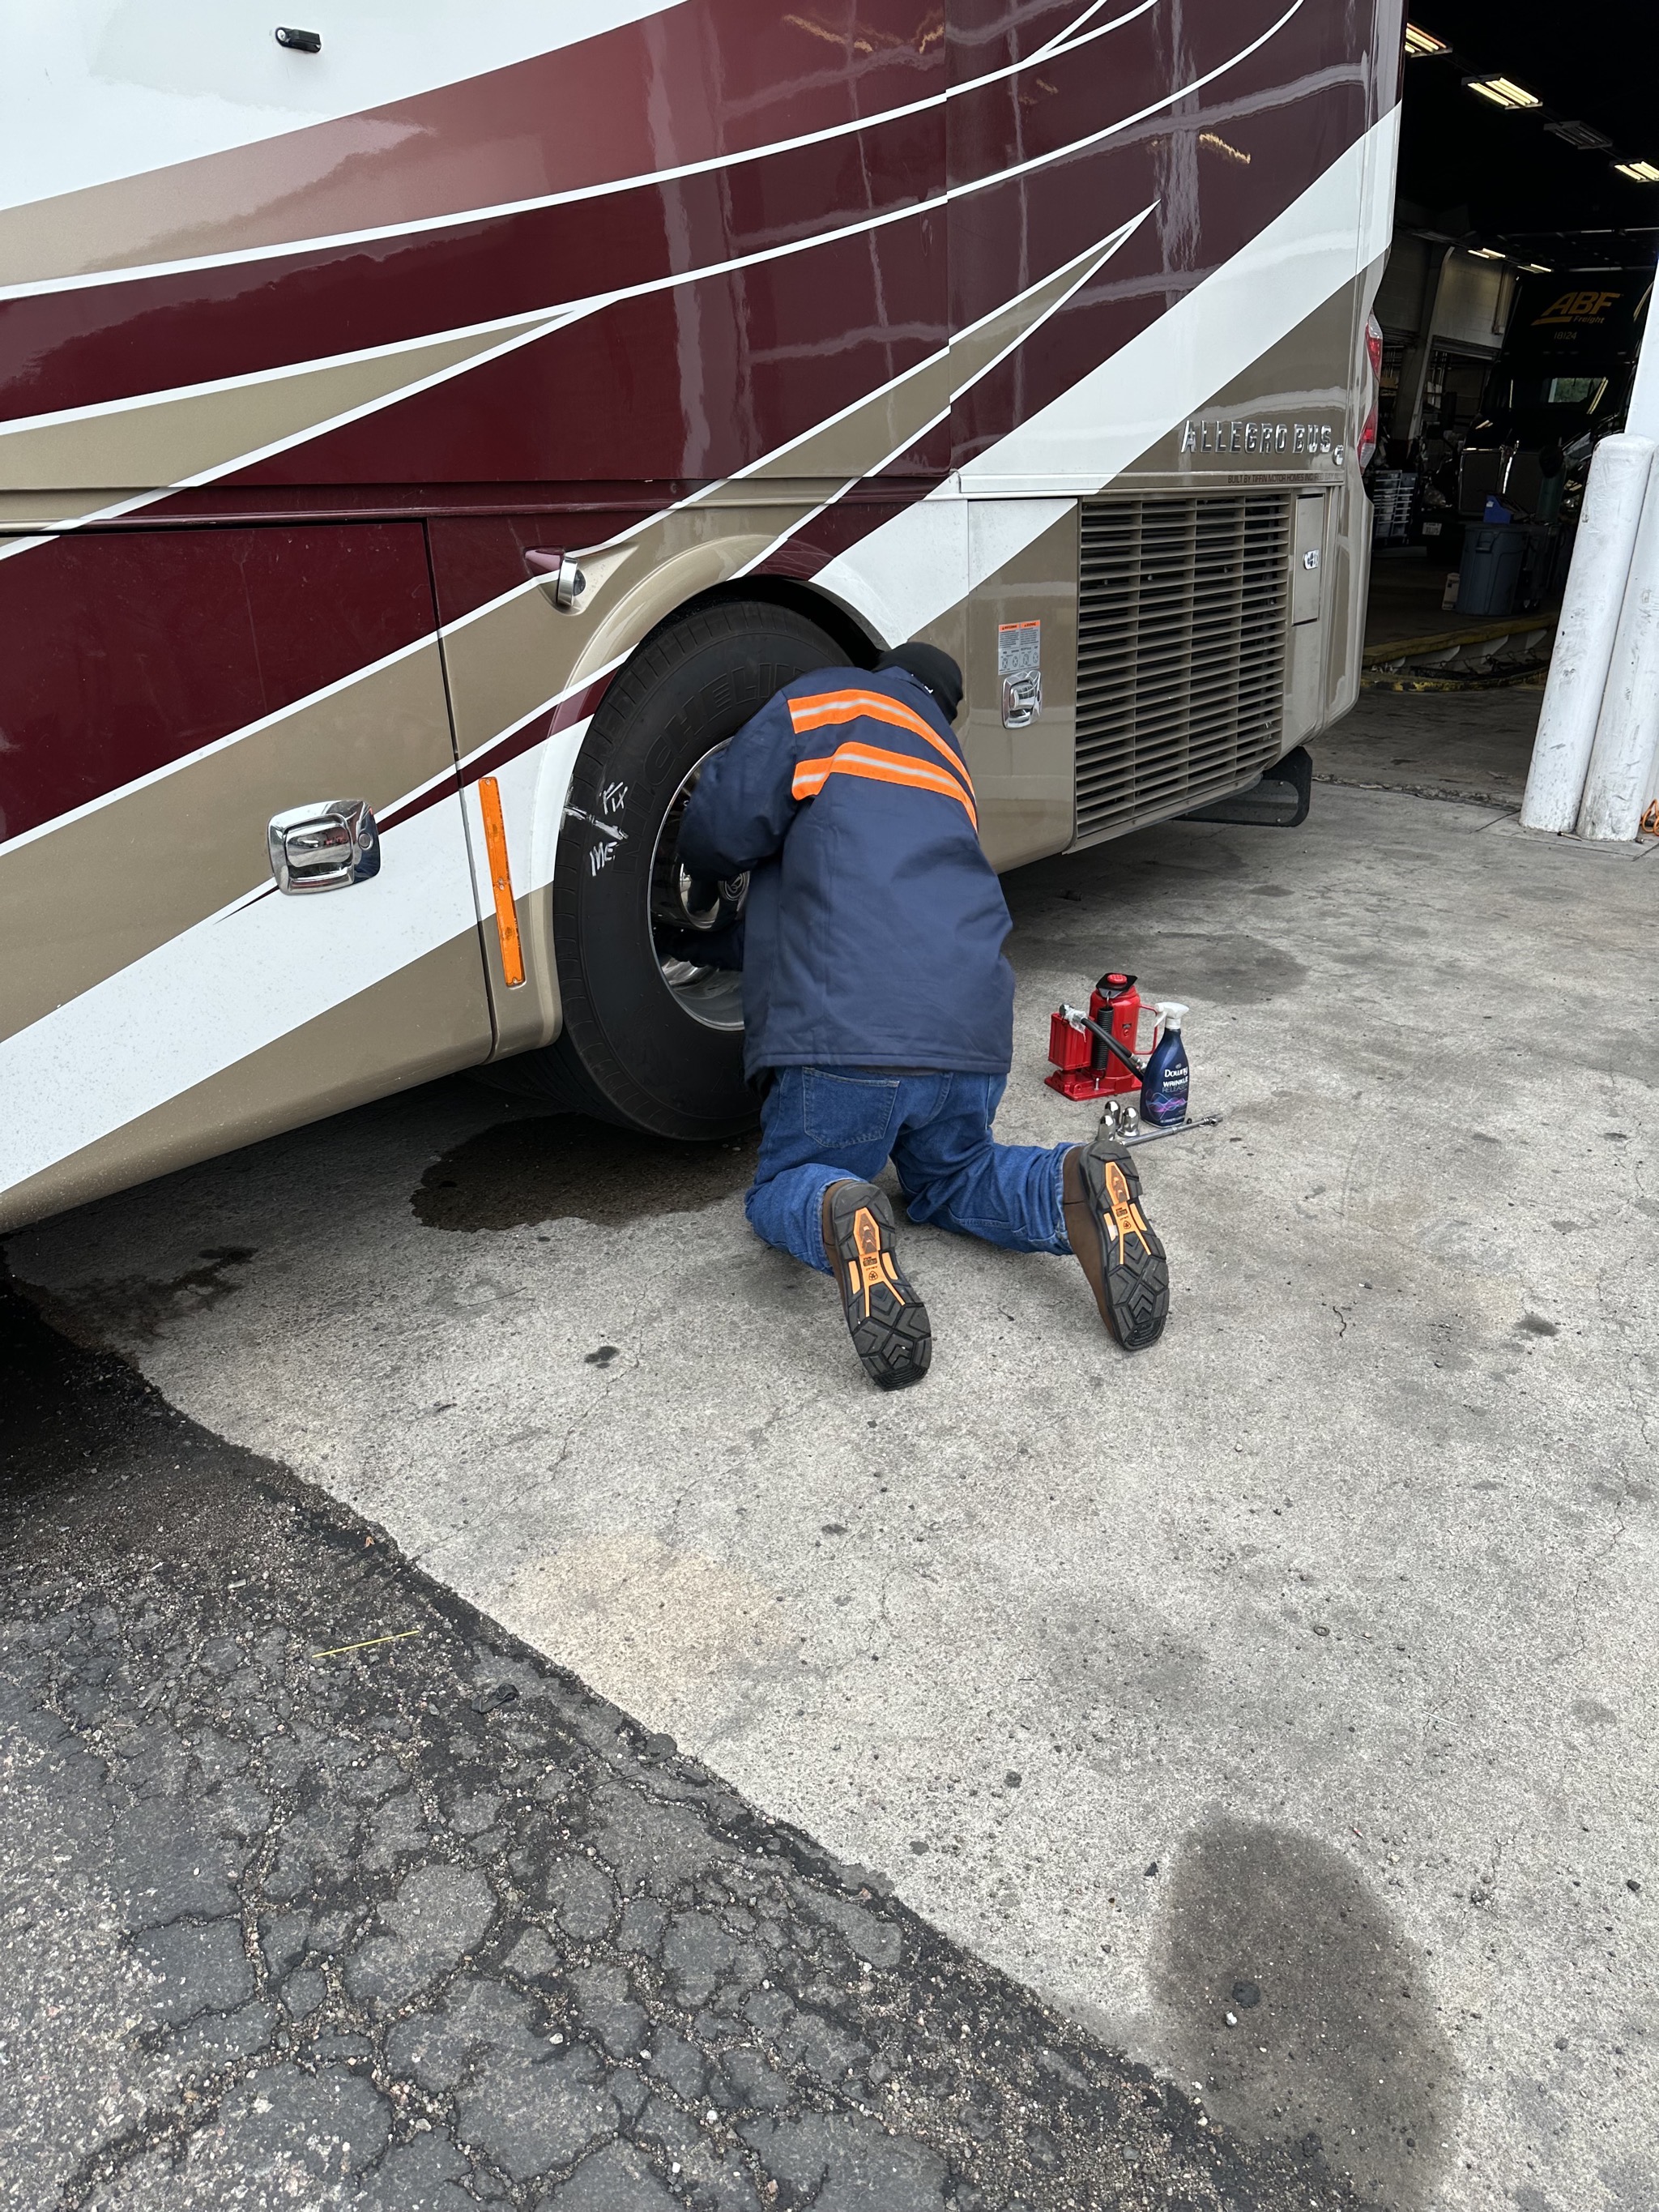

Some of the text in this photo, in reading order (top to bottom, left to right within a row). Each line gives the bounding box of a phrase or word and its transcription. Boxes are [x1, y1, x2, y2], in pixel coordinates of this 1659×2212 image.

[1541, 292, 1621, 317] ABF
[1574, 315, 1605, 324] Freight
[1554, 331, 1577, 340] 18124
[1181, 420, 1332, 454] ALLEGRO BUS
[1227, 475, 1243, 484] BUILT
[1243, 474, 1251, 484] BY
[1252, 474, 1268, 483] TIFFIN
[1268, 474, 1286, 483] MOTOR
[1286, 473, 1304, 482] HOMES
[1164, 1067, 1188, 1078] Downy
[1162, 1076, 1188, 1087] WRINKLE
